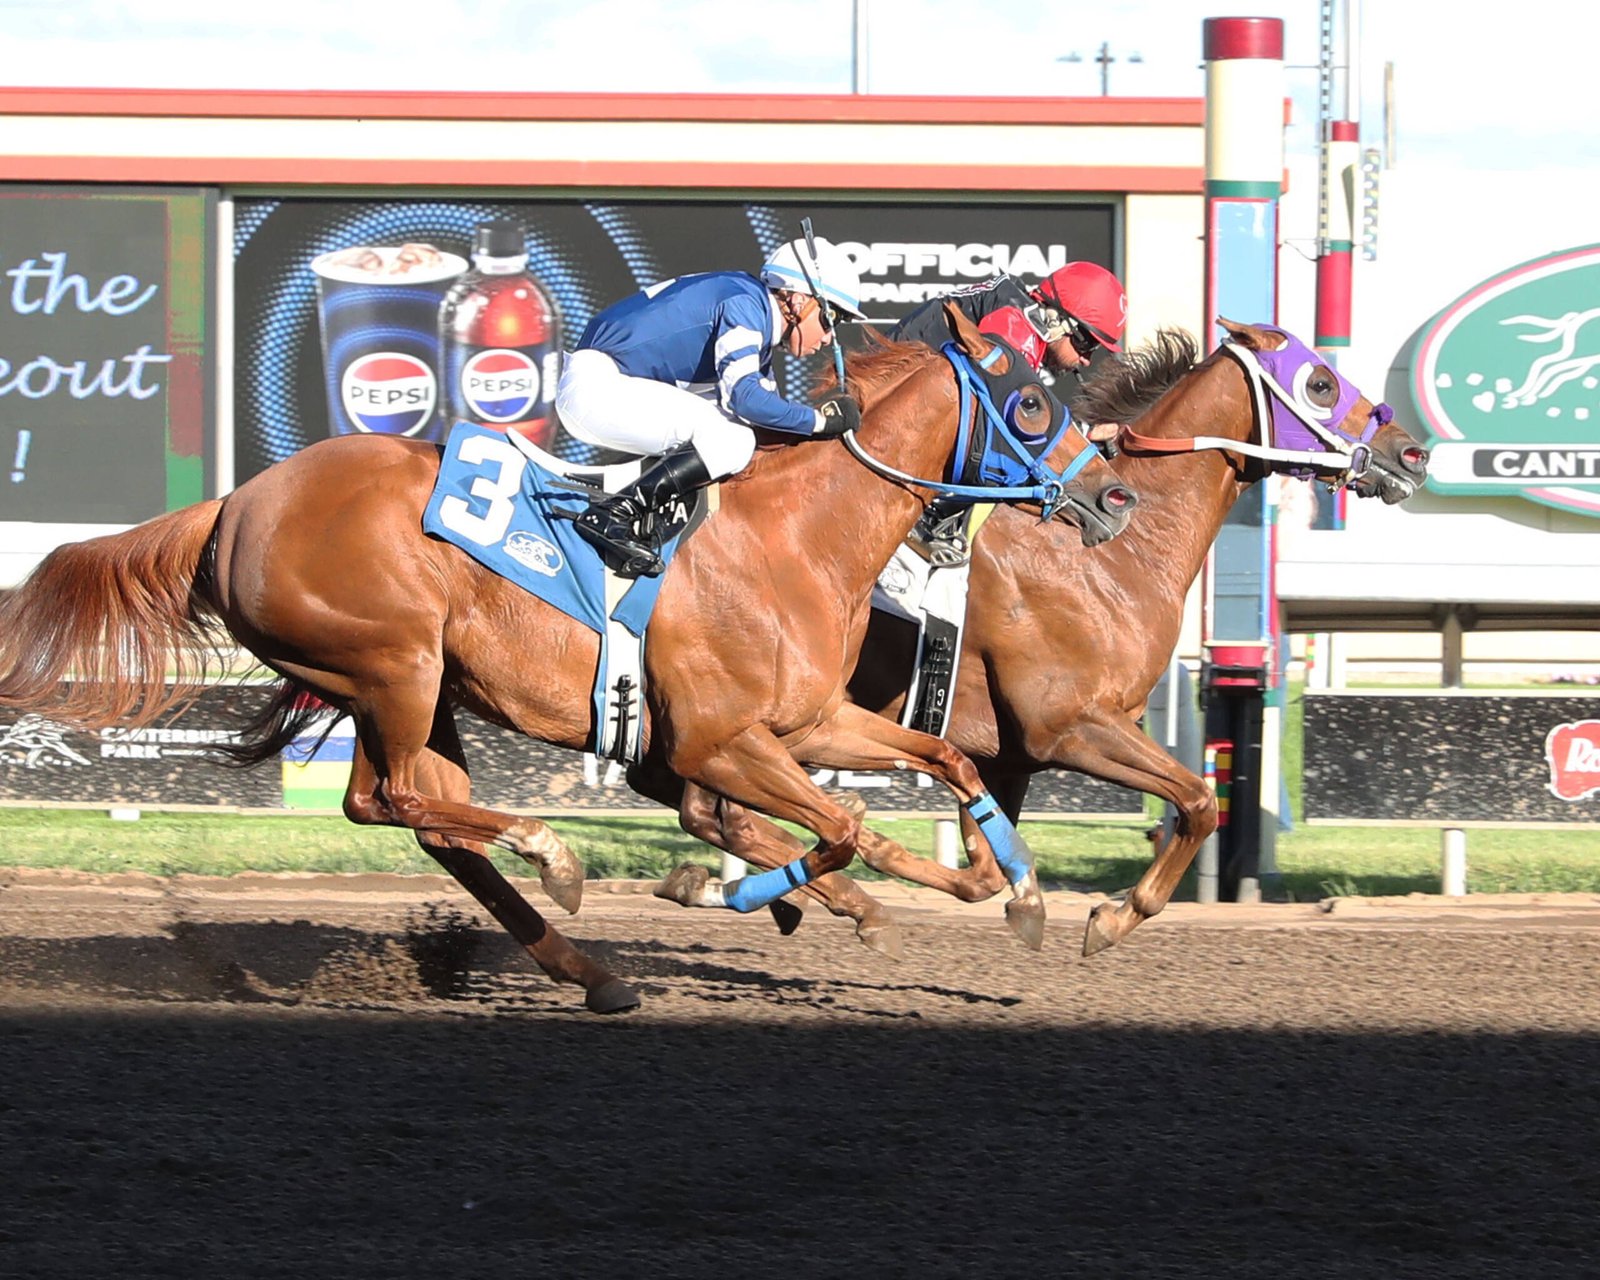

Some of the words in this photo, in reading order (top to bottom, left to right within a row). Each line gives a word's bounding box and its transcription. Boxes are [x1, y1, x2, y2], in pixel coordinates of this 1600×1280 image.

[6, 252, 159, 315] the
[351, 386, 430, 405] PEPSI
[470, 377, 532, 392] PEPSI
[1493, 451, 1600, 477] CANT
[439, 434, 528, 547] 3
[101, 743, 162, 759] PARK
